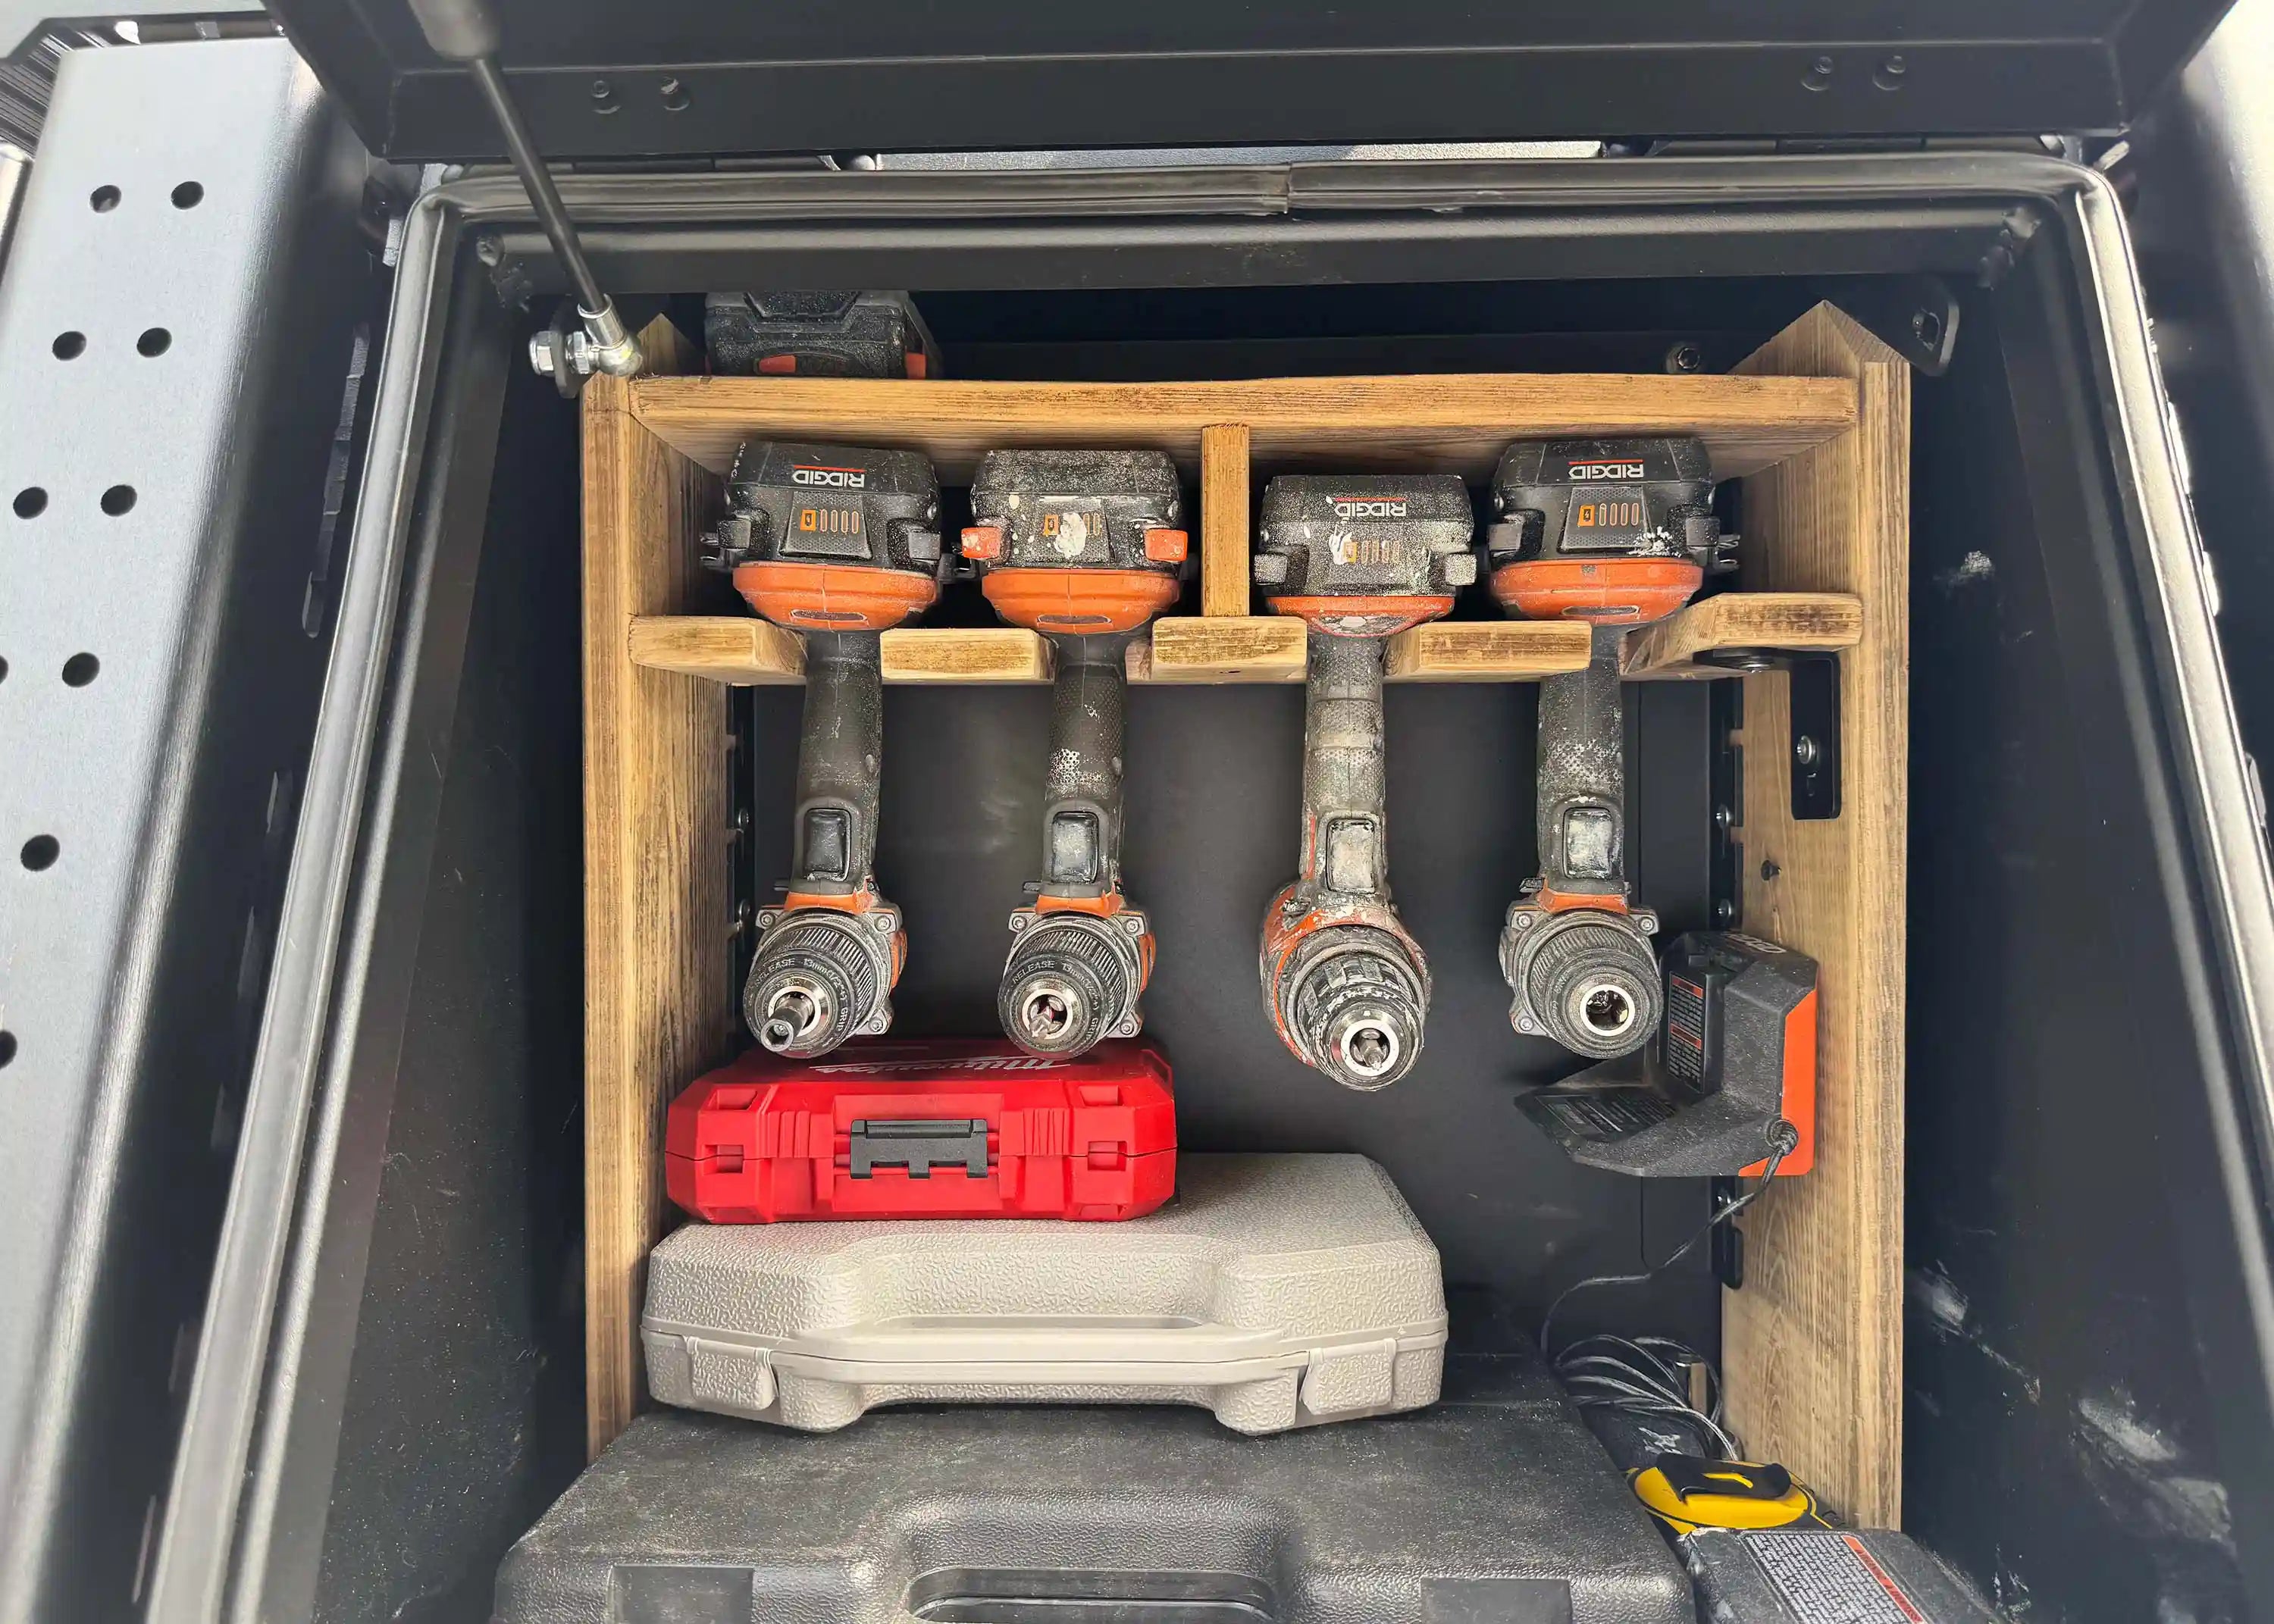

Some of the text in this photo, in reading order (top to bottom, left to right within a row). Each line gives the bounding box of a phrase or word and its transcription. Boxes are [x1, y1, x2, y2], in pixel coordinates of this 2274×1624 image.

[792, 470, 865, 488] RIDGID
[1568, 465, 1644, 479] RIDGID
[1334, 502, 1406, 517] RIDGID
[1013, 960, 1055, 984] RELEASE
[837, 1006, 849, 1031] GRIP
